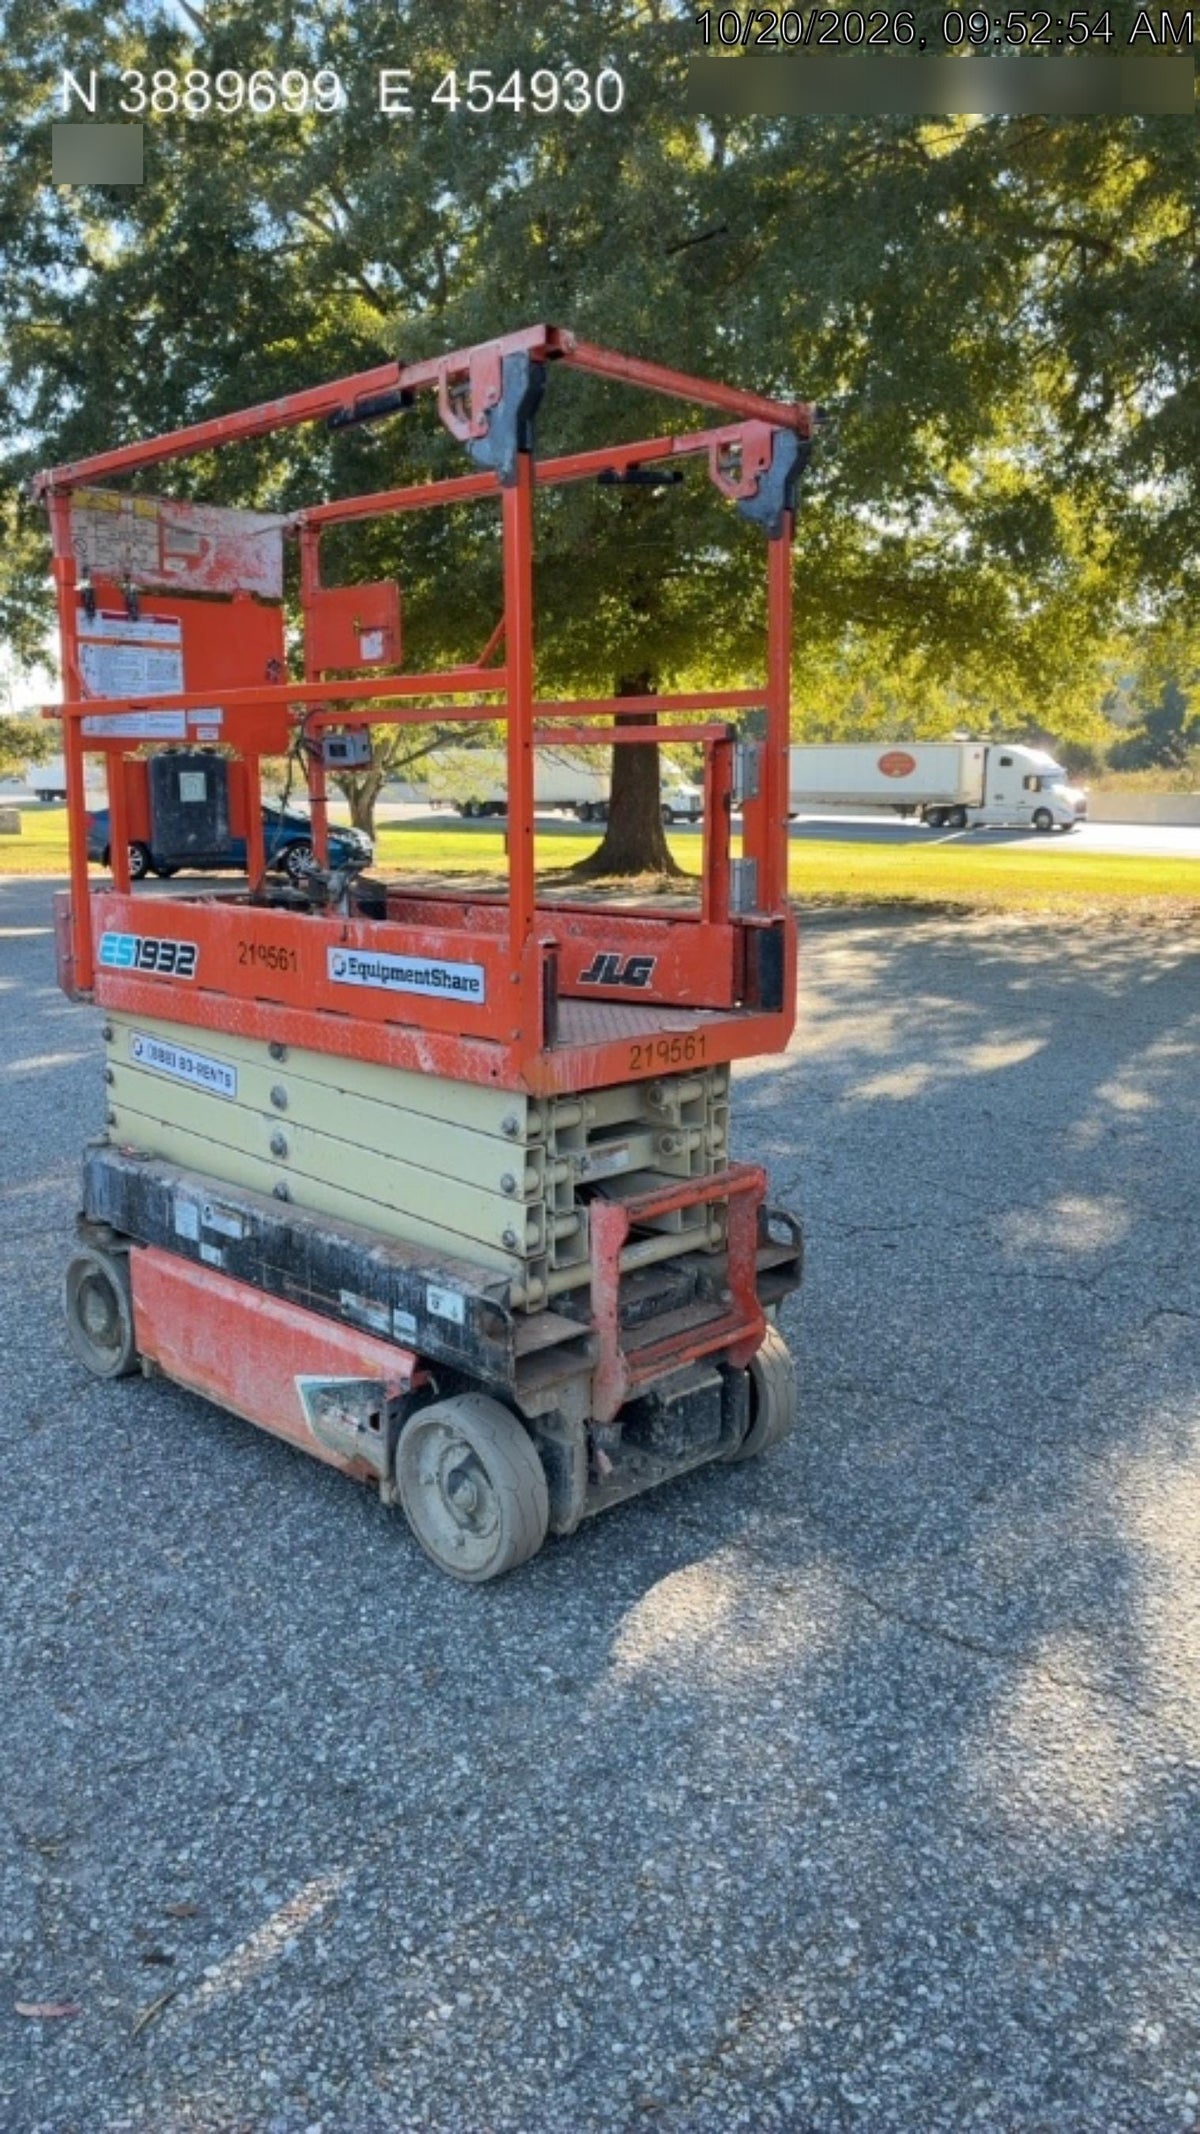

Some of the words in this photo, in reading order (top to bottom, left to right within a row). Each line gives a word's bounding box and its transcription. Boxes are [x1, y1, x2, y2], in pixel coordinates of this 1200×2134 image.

[99, 932, 197, 979] ES1932
[238, 941, 299, 973] 219561
[577, 951, 657, 989] JLG
[348, 957, 480, 992] EquipmentShare
[629, 1034, 707, 1071] 219561
